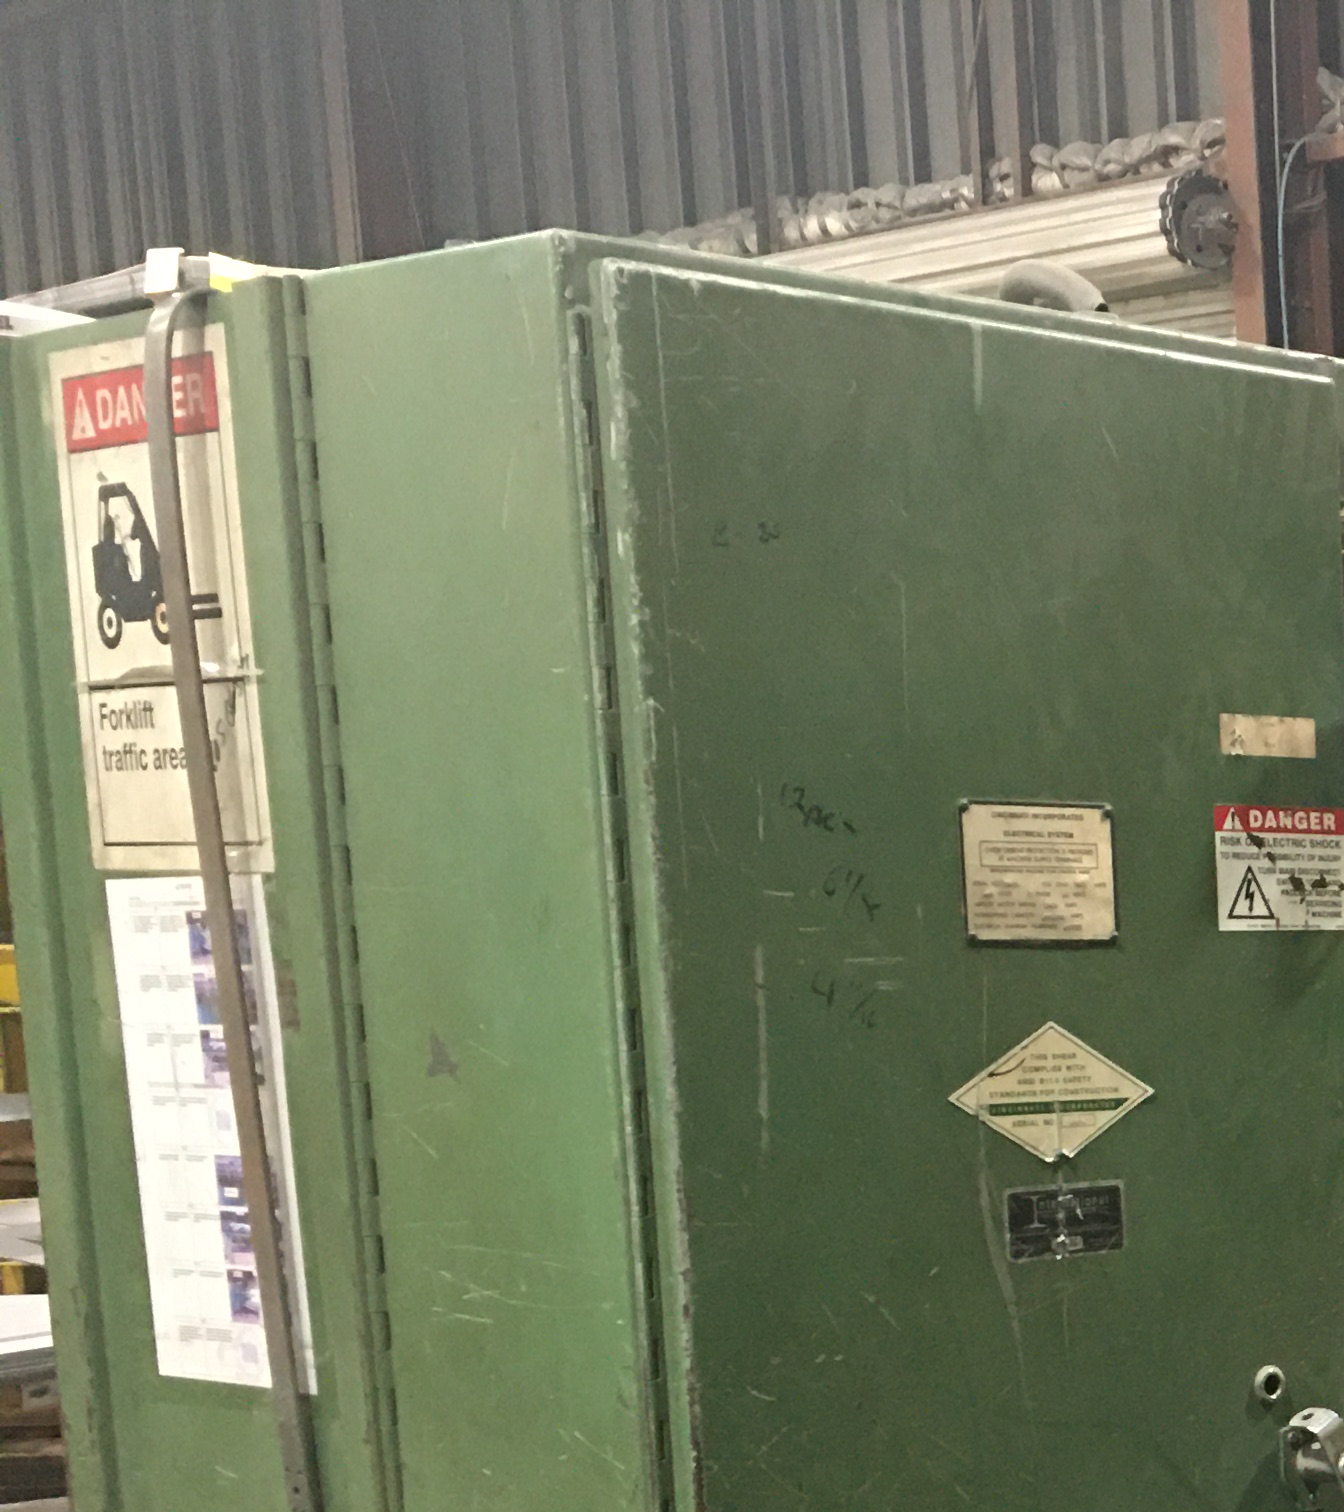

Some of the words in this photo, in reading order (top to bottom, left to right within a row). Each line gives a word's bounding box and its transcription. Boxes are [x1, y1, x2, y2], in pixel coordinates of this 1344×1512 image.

[96, 373, 207, 430] DANER
[99, 700, 155, 731] Forklift
[103, 742, 148, 772] traffic
[152, 746, 188, 771] area
[1248, 808, 1336, 831] DANGER
[1220, 836, 1242, 847] RISK
[1309, 839, 1341, 850] SHOCK
